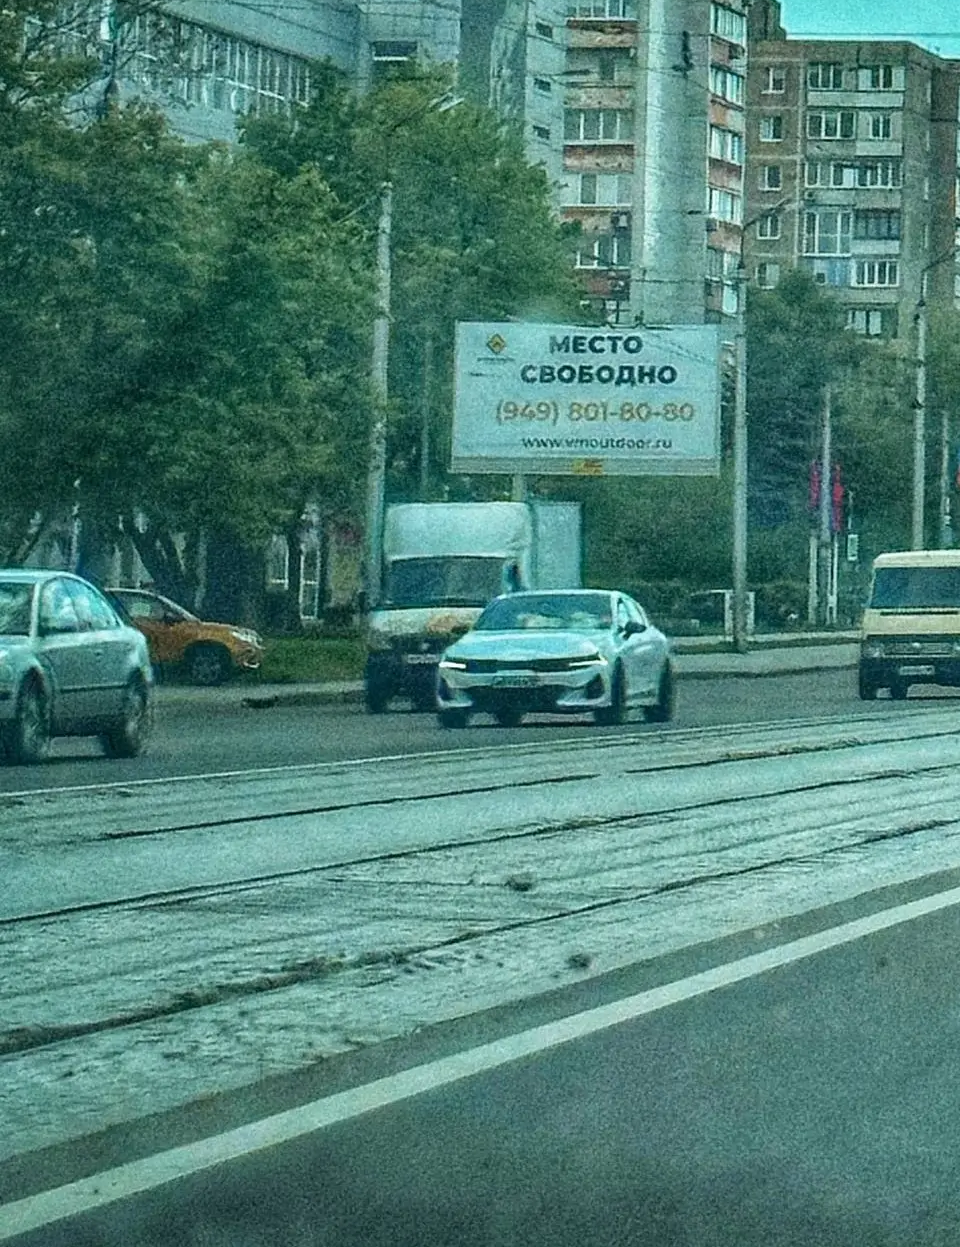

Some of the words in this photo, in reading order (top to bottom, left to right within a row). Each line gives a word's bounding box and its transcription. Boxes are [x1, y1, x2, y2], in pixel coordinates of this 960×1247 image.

[551, 335, 643, 354] МЕСТО
[520, 365, 679, 386] СВОБОДНО
[496, 400, 559, 426] (949)
[568, 402, 696, 422] 801-80-80
